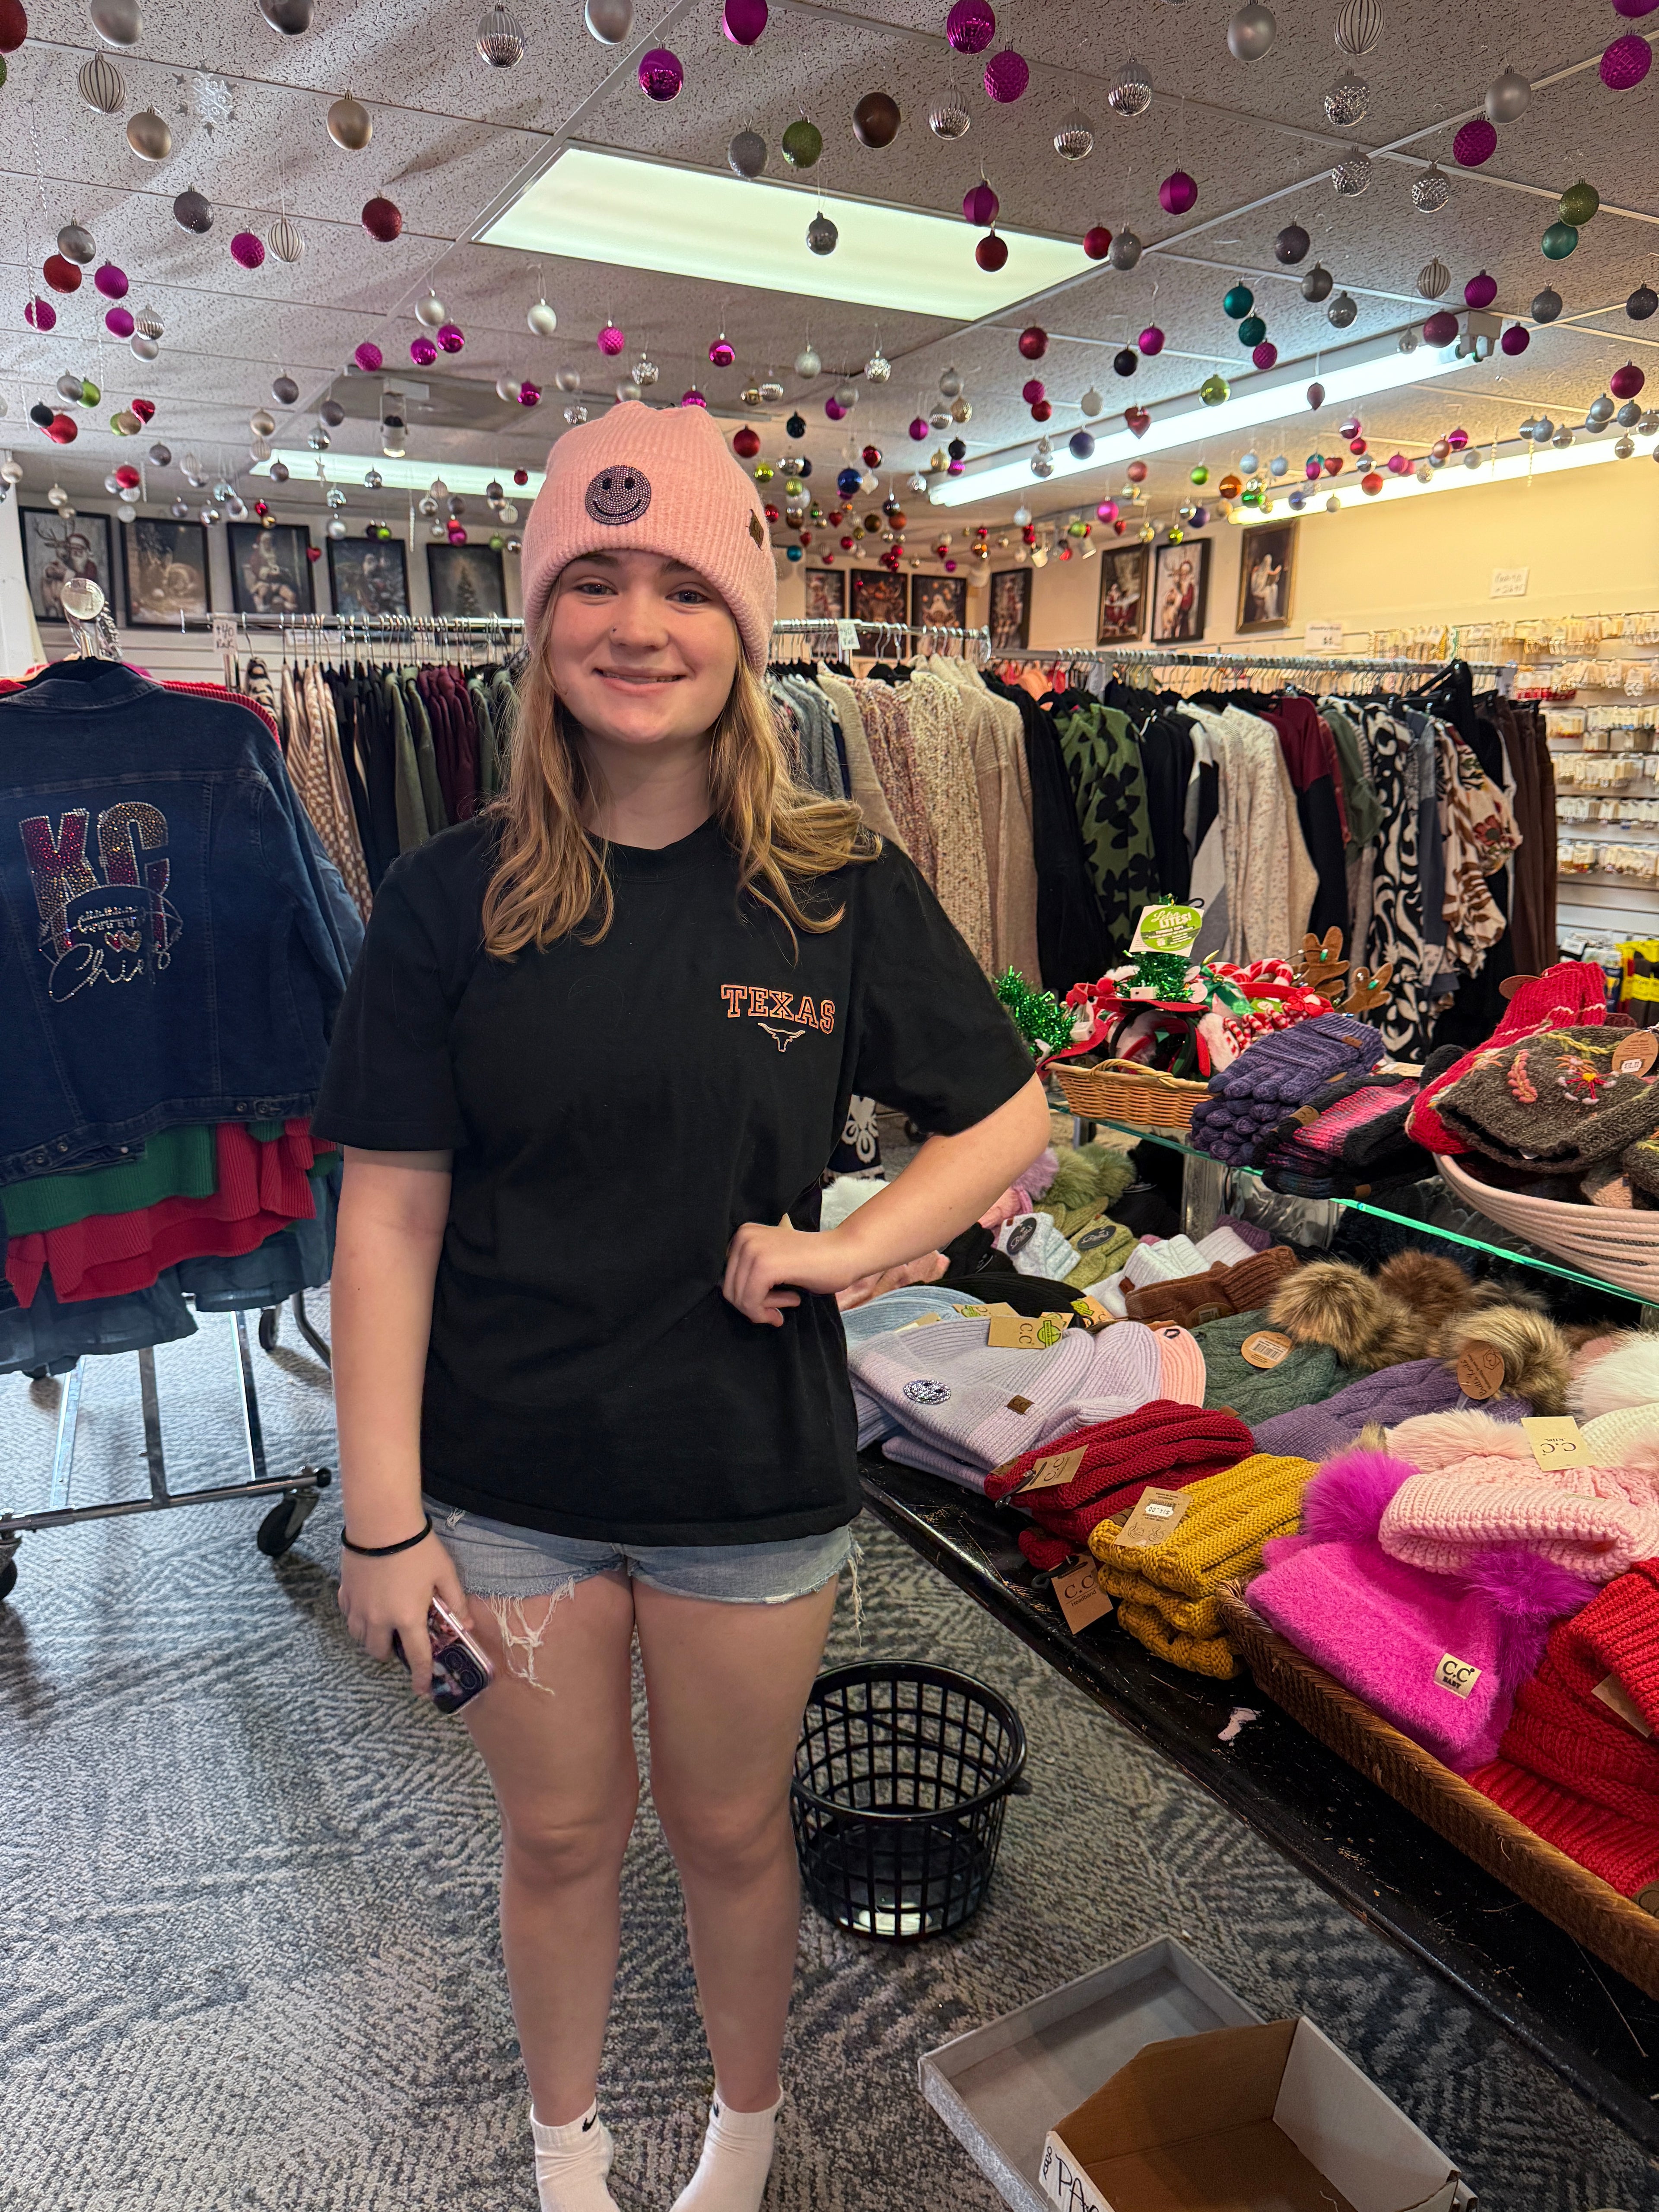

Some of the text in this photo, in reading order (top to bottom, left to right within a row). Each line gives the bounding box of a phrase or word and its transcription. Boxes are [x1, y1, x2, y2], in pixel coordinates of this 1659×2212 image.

[1159, 912, 1192, 928] LITES!
[721, 984, 836, 1034] TEXAS
[1065, 1574, 1094, 1599] C.C
[1071, 1589, 1096, 1607] Headband
